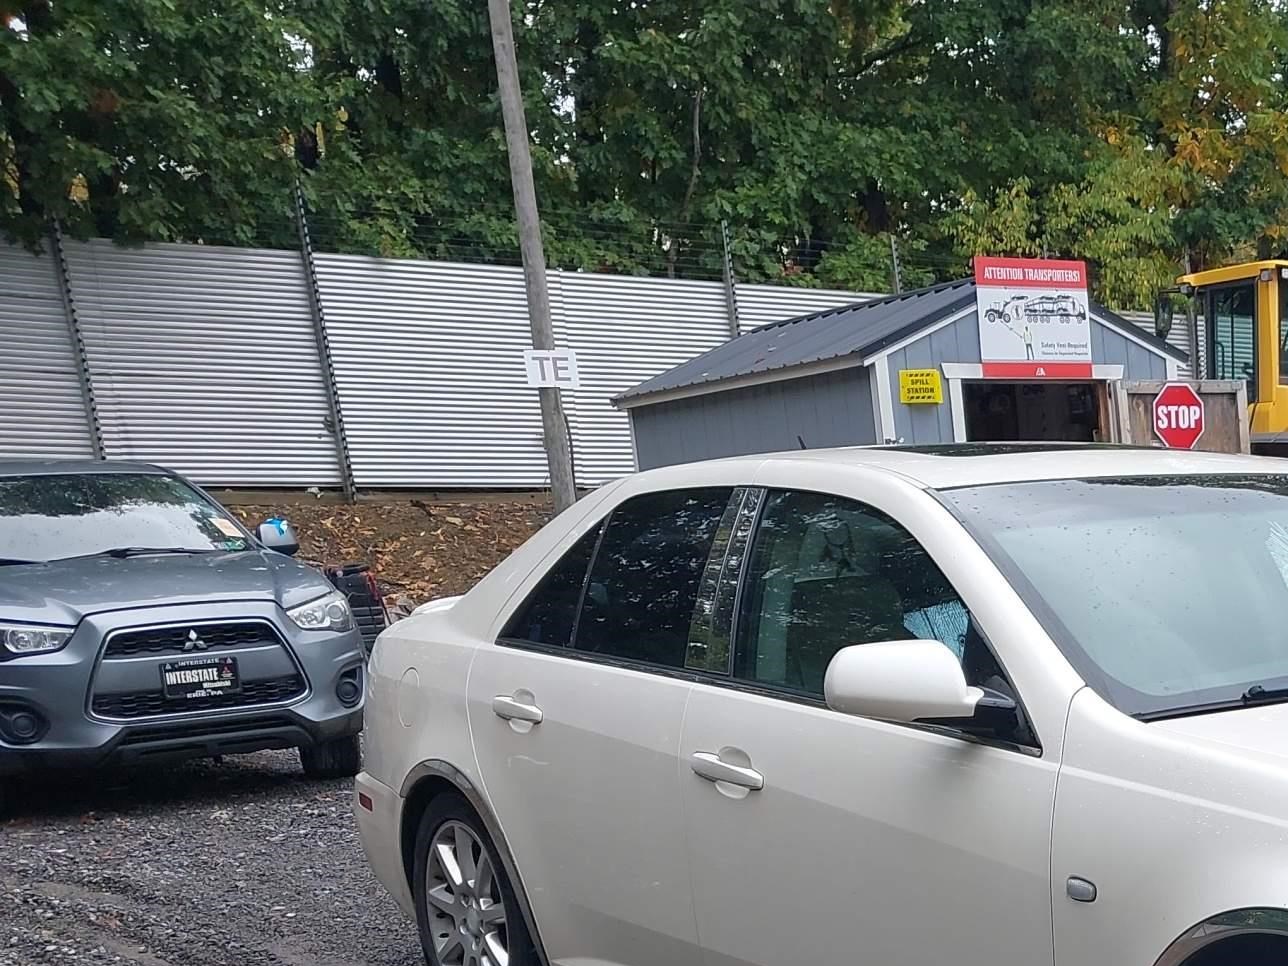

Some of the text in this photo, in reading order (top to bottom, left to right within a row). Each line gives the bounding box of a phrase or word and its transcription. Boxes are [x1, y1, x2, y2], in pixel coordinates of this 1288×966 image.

[983, 266, 1081, 283] ATTENTION TRANSPORTERS!
[531, 356, 572, 382] TE
[1157, 405, 1201, 429] STOP
[165, 667, 219, 685] INTERSTATE
